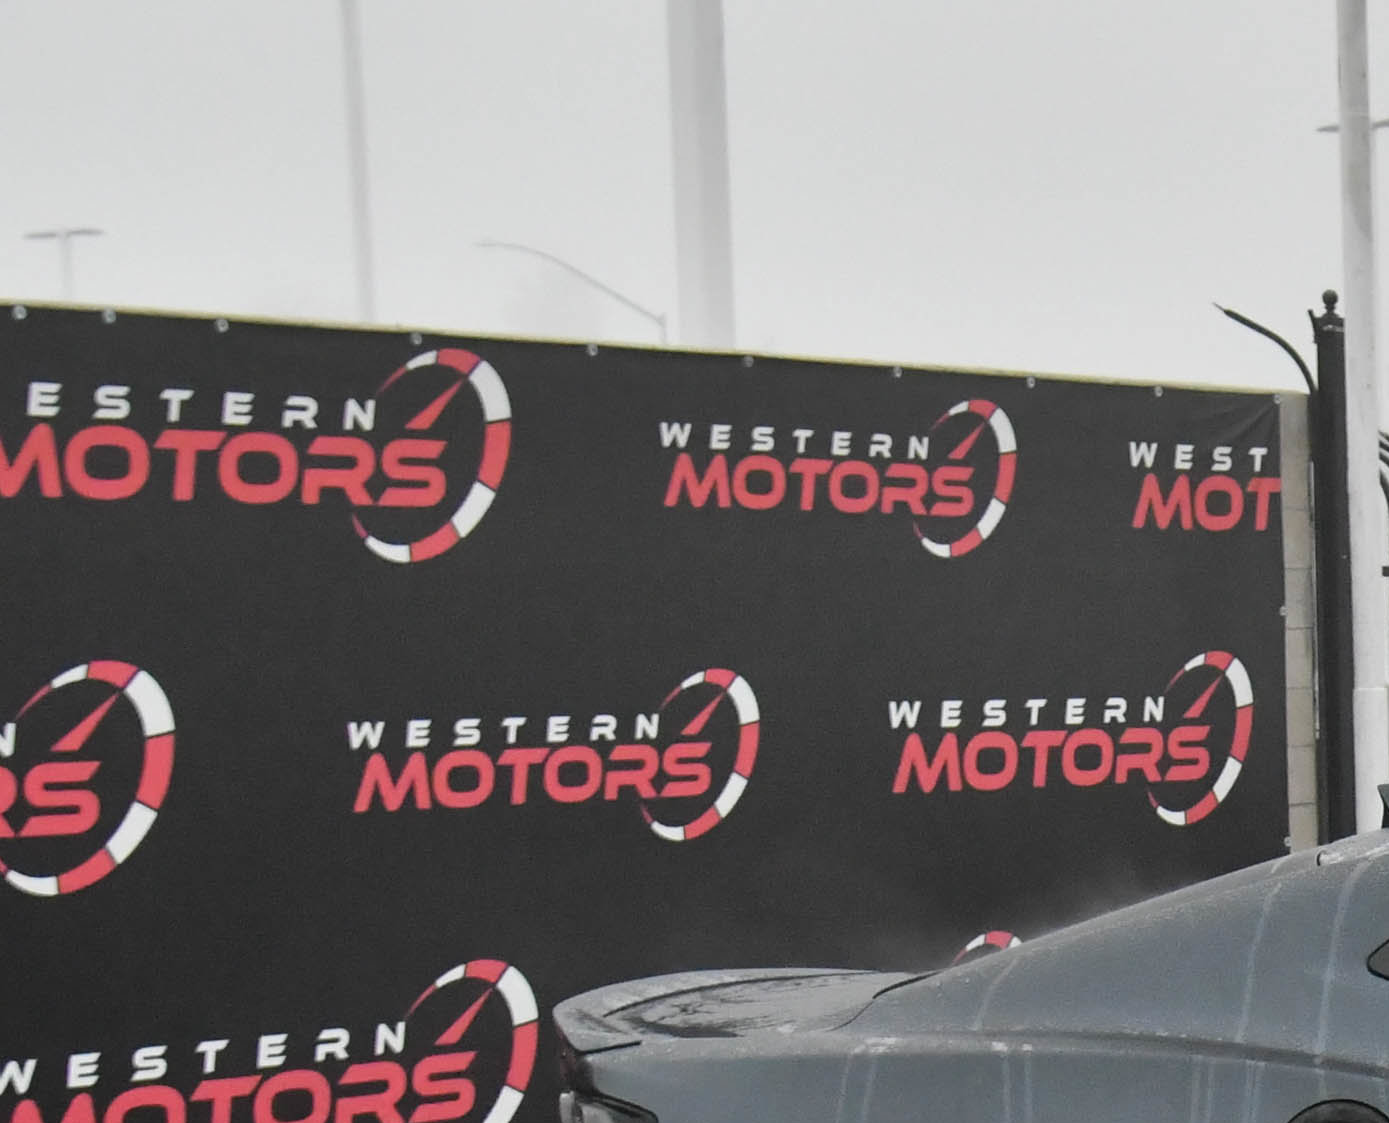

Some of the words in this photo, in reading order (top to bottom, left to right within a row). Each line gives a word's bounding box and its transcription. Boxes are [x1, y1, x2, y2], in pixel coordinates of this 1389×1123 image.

[0, 423, 447, 507] MOTORS
[660, 421, 930, 460] WESTERN
[1129, 441, 1269, 473] WEST
[663, 452, 975, 517] MOTORS
[1132, 473, 1281, 531] MOT
[347, 713, 661, 750] WESTERN
[888, 696, 1166, 729] WESTERN
[353, 741, 713, 813] MOTORS
[892, 725, 1211, 793] MOTORS
[0, 1021, 407, 1095] WESTERN
